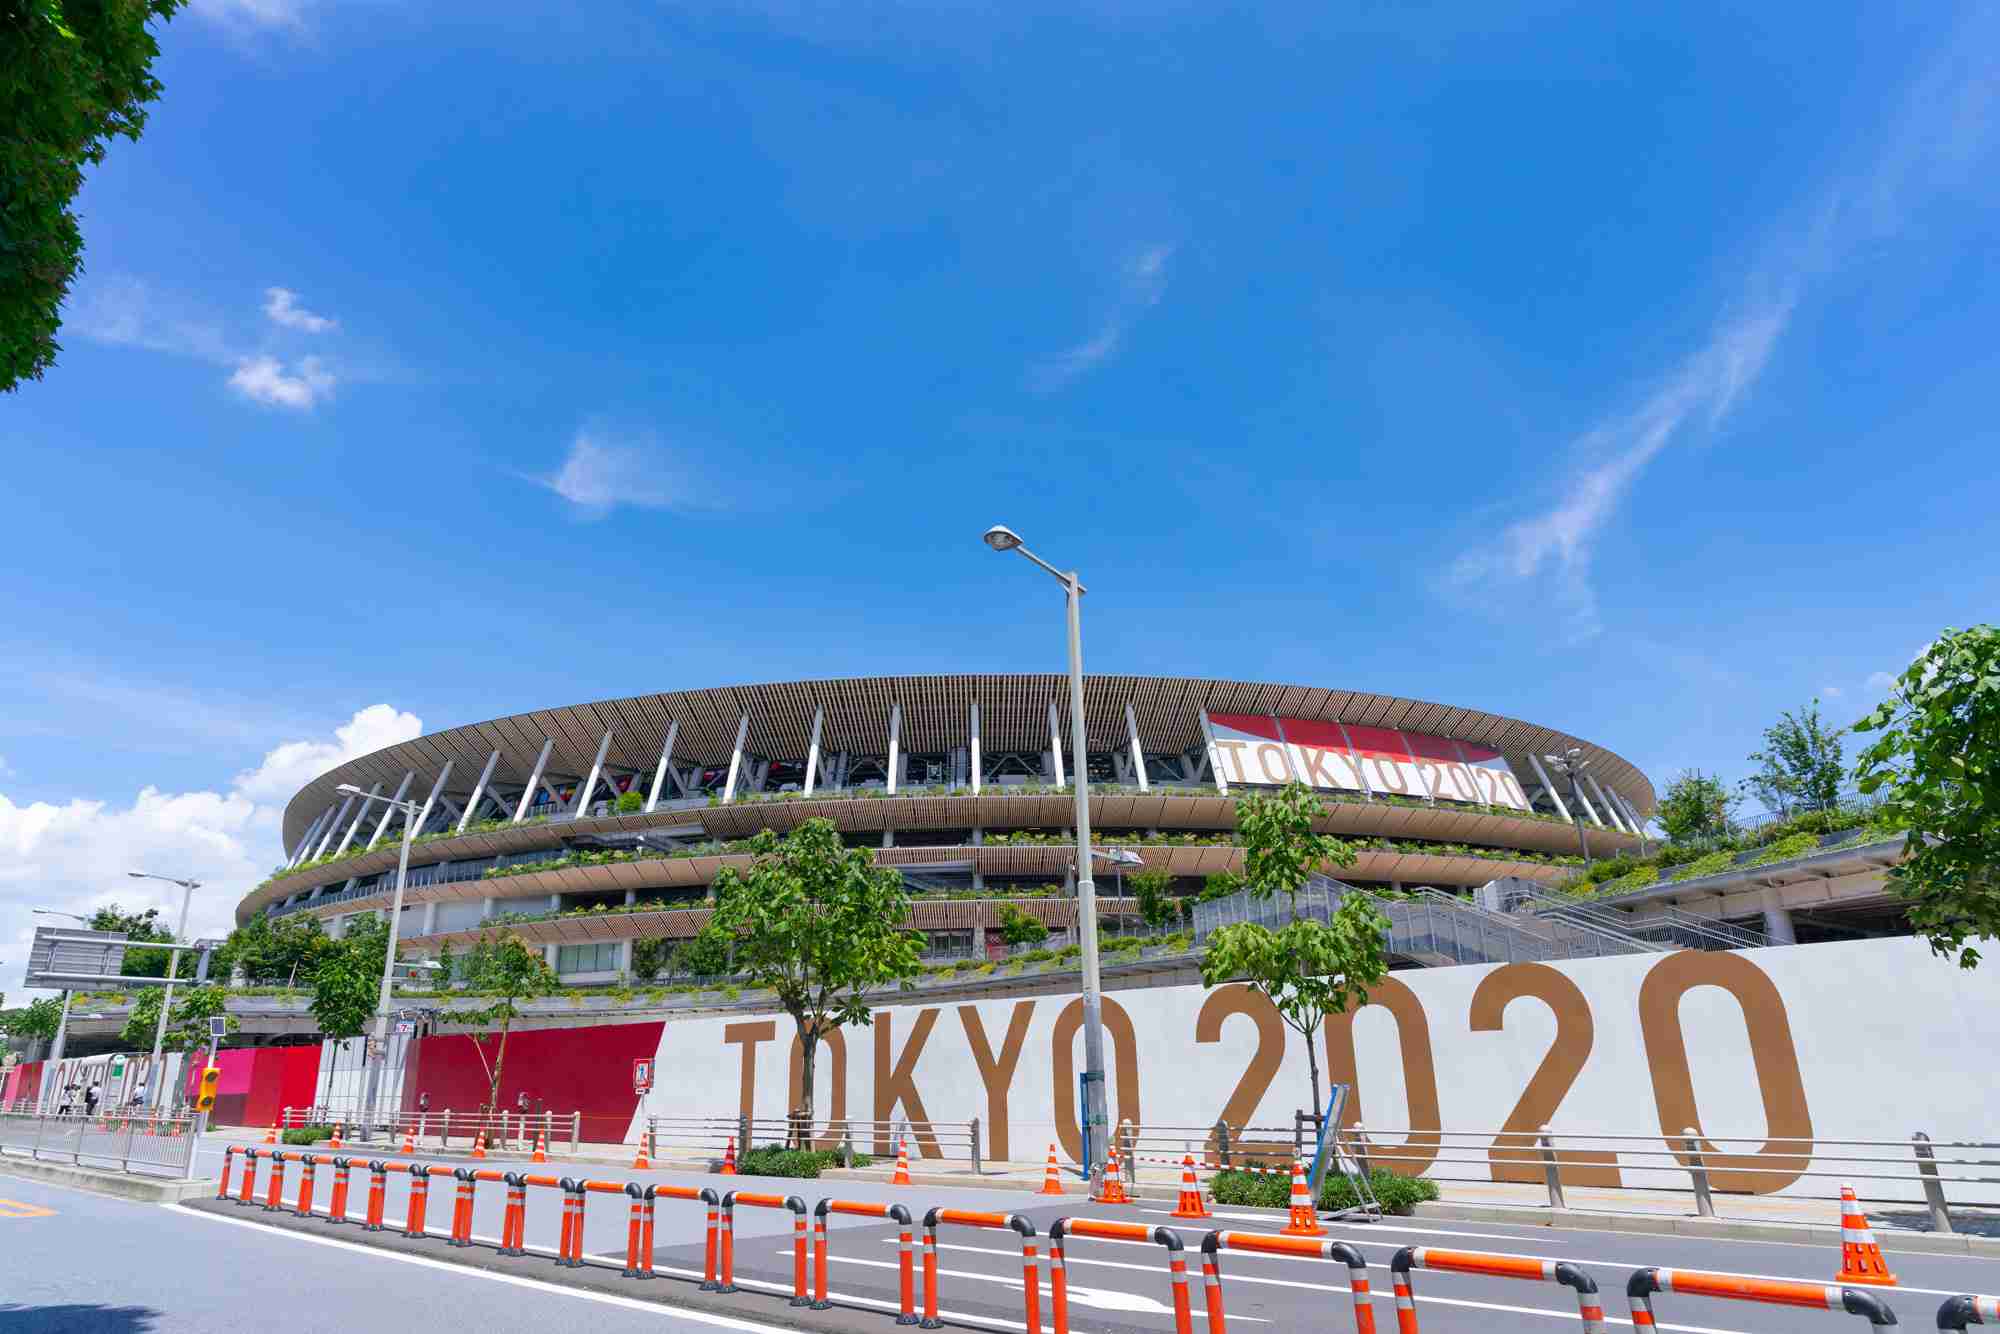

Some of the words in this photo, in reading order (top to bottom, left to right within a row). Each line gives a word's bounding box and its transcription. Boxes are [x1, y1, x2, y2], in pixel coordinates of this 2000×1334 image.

[1216, 740, 1409, 794] TOKYO
[1419, 759, 1529, 809] 2020
[724, 996, 1140, 1165] TOKYO
[1196, 949, 1814, 1195] 2020
